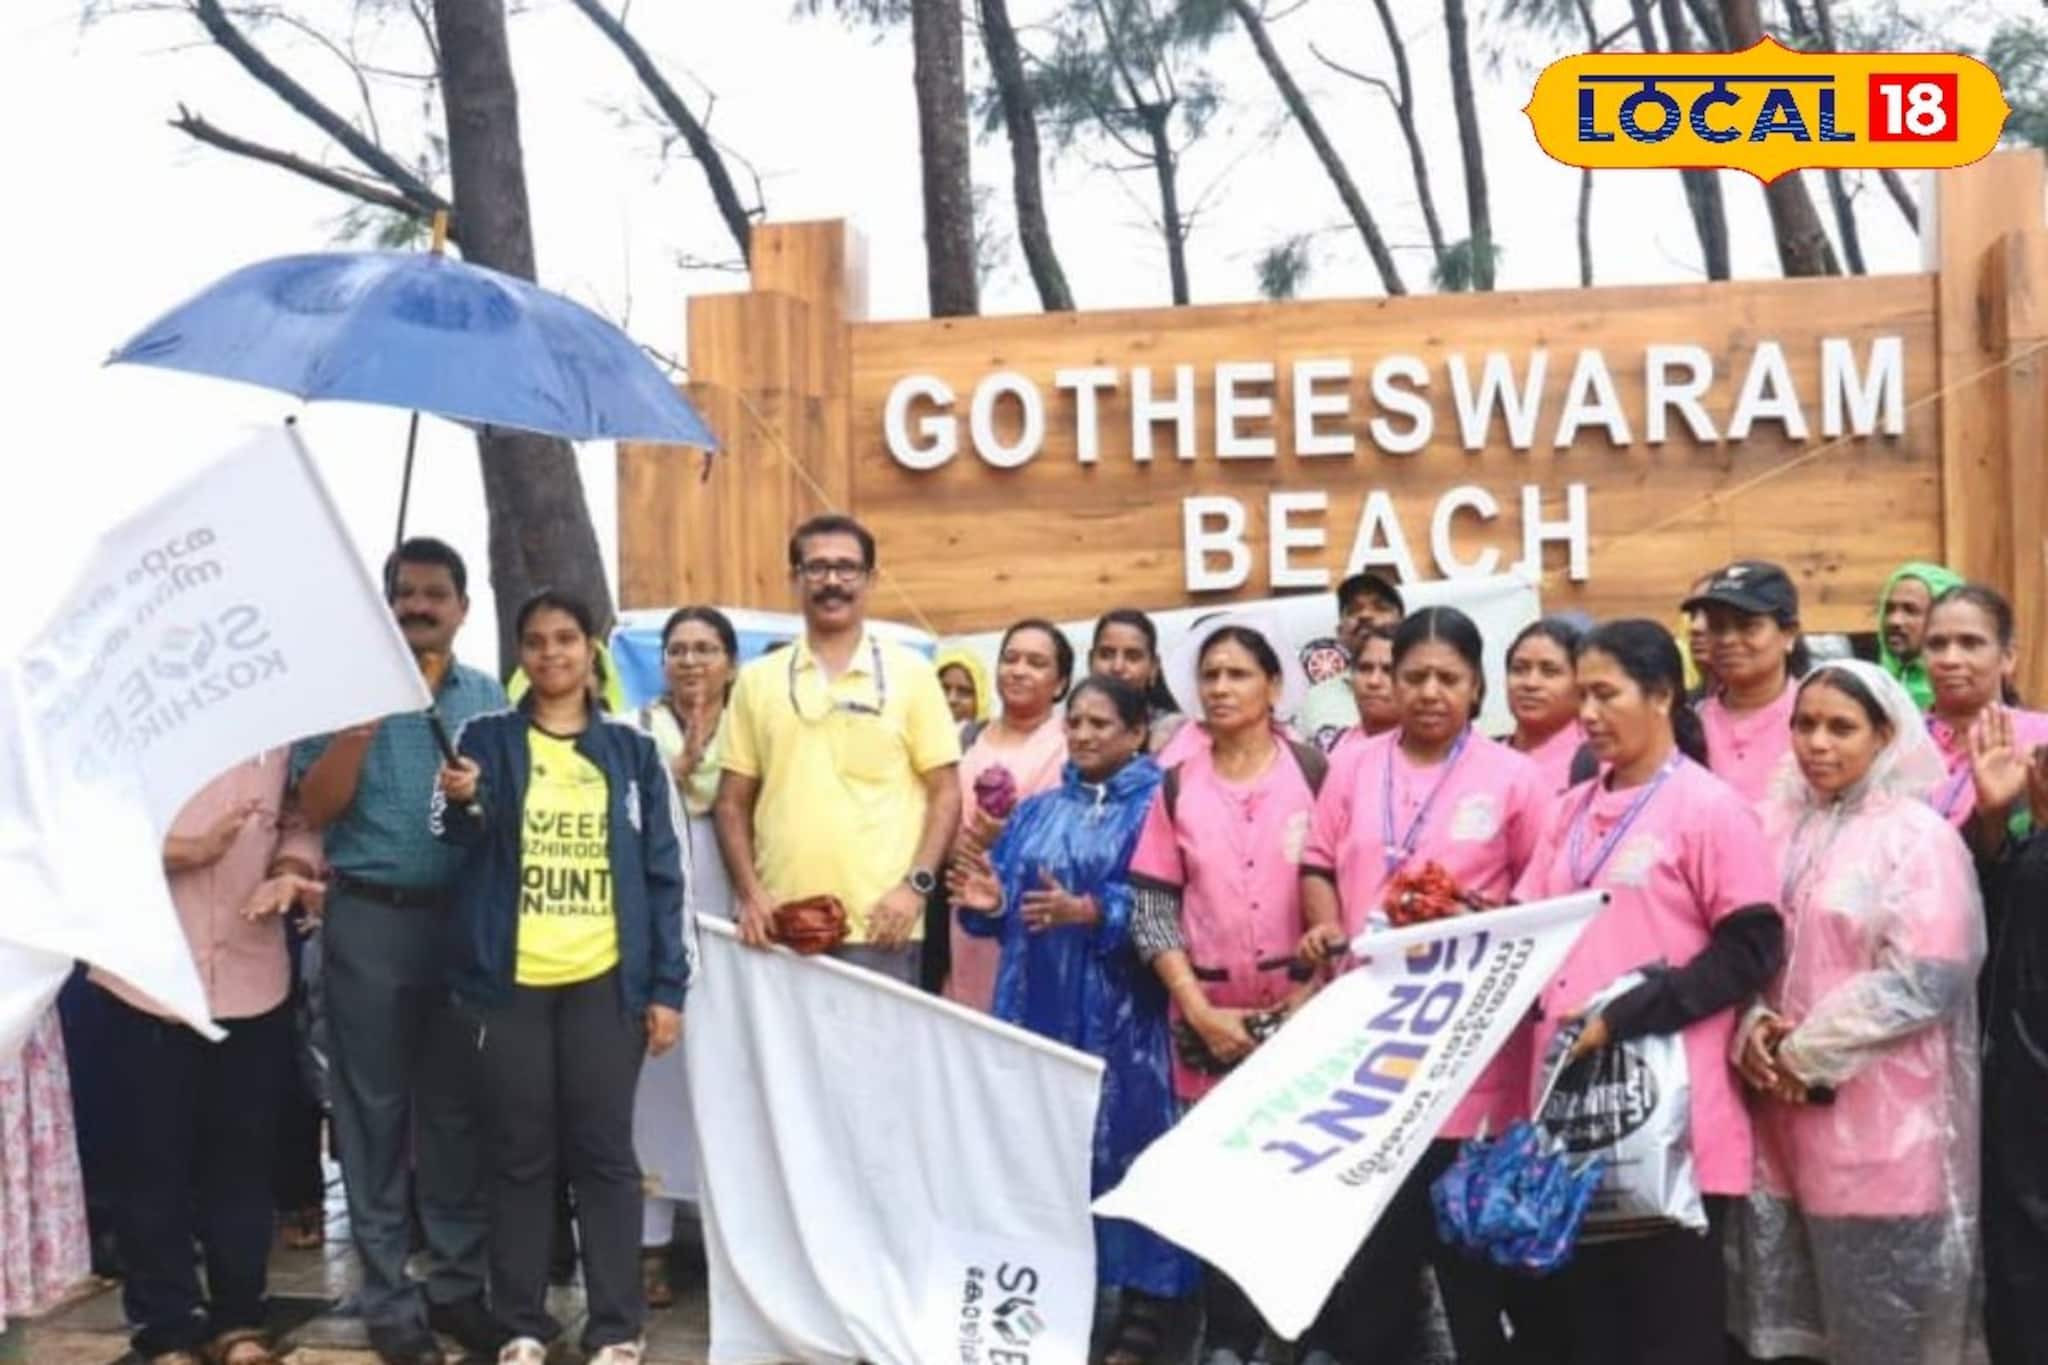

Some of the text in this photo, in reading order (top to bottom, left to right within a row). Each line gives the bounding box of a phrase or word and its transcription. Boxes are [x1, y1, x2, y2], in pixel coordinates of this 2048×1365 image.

[883, 336, 1907, 472] GOTHEESWARAM
[1183, 483, 1590, 593] BEACH
[523, 865, 610, 901] OUNT
